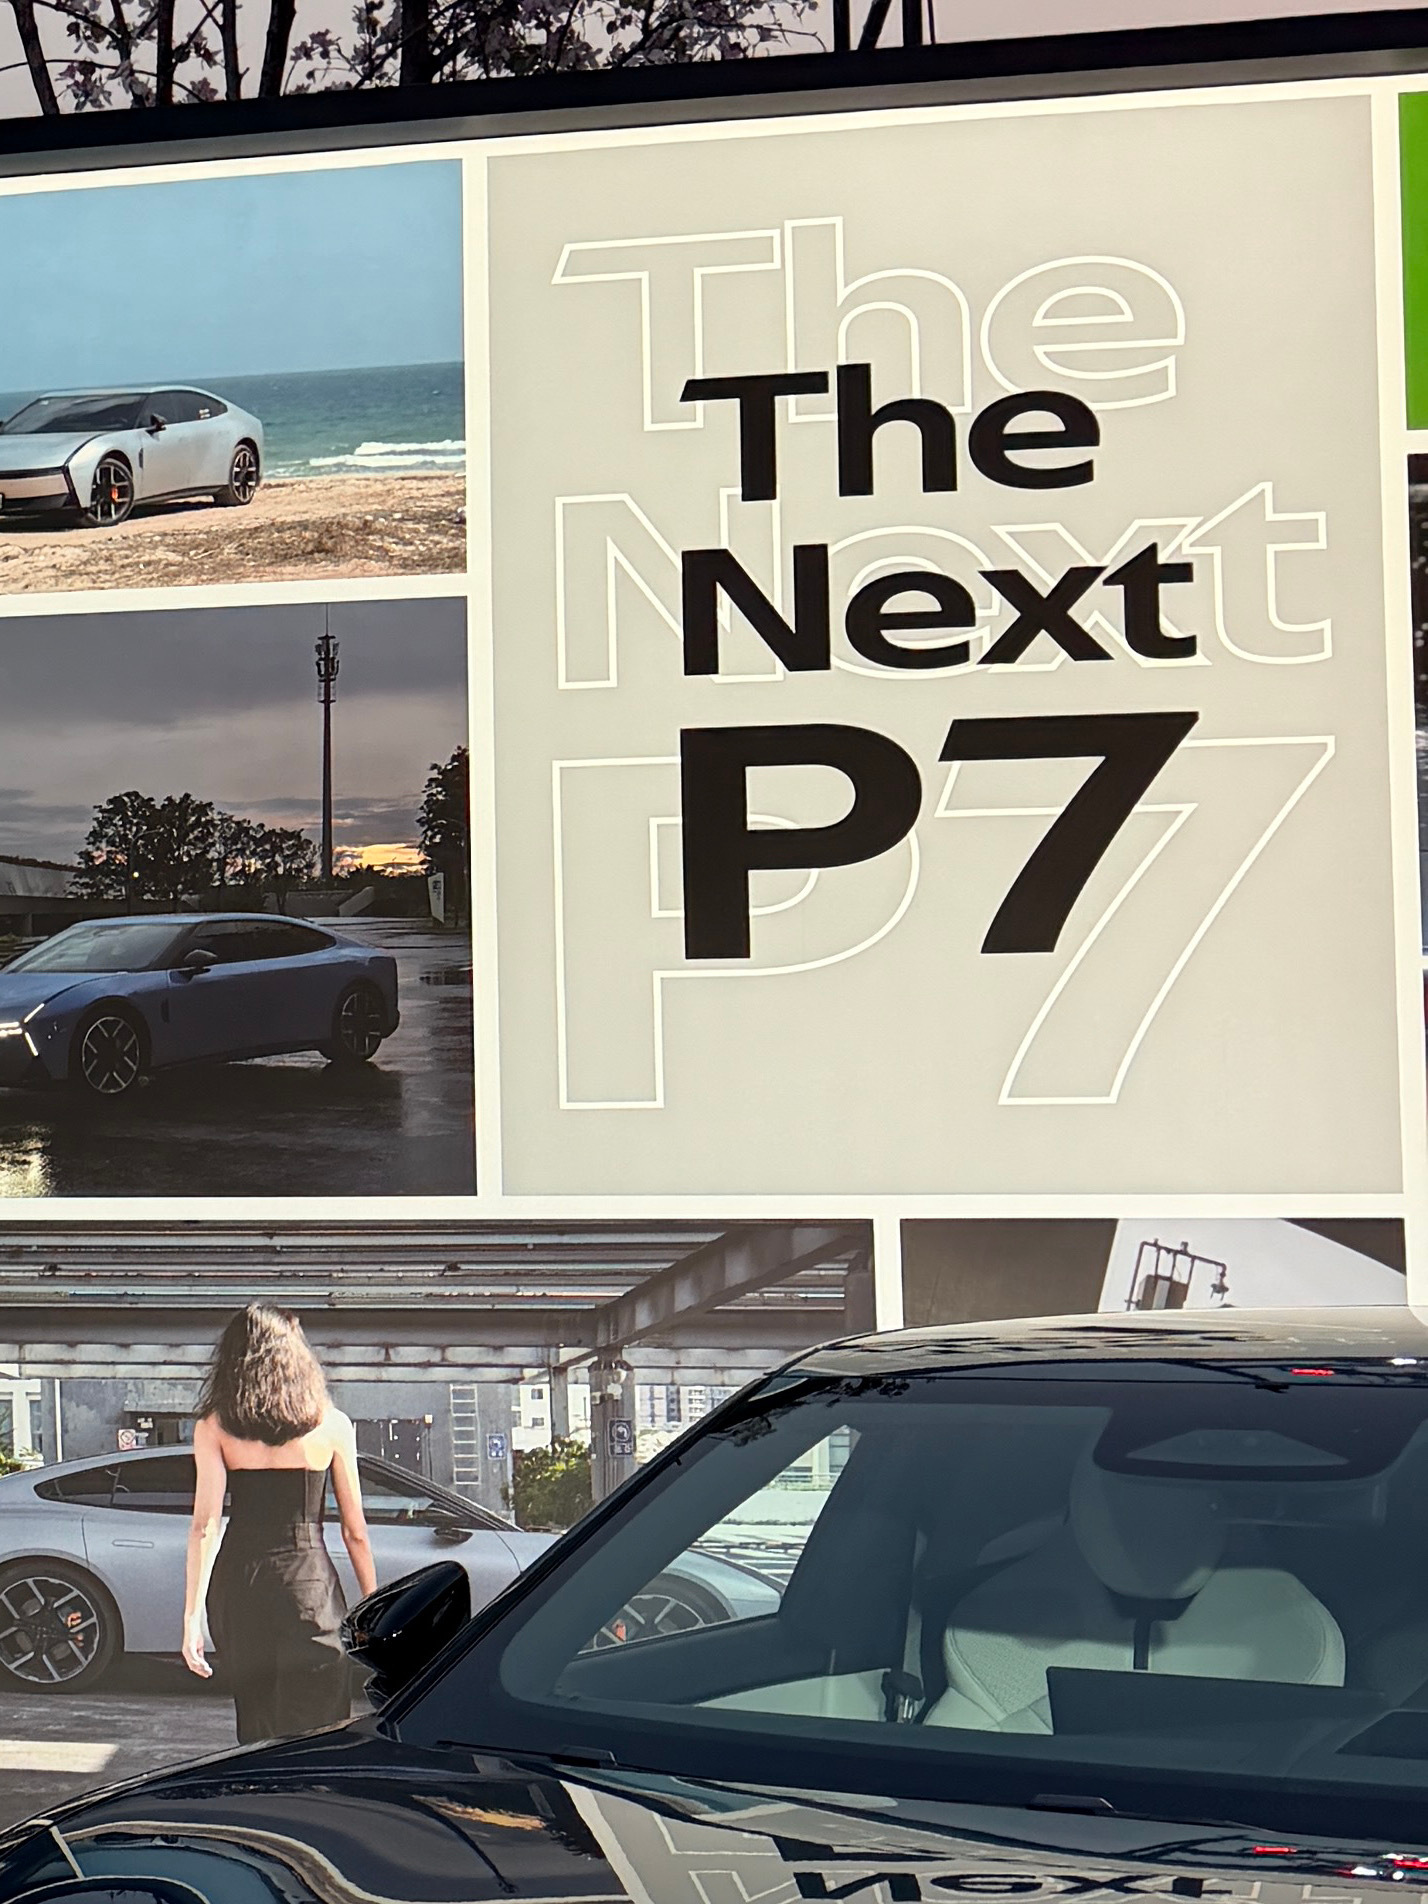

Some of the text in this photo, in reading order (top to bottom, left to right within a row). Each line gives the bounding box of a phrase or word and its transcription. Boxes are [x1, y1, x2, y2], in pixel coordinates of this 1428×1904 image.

[551, 215, 1186, 431] The
[679, 362, 1101, 502] The
[555, 481, 1332, 689] Next
[681, 542, 1198, 676] Next
[551, 735, 1335, 1110] P7
[680, 711, 1200, 960] P7
